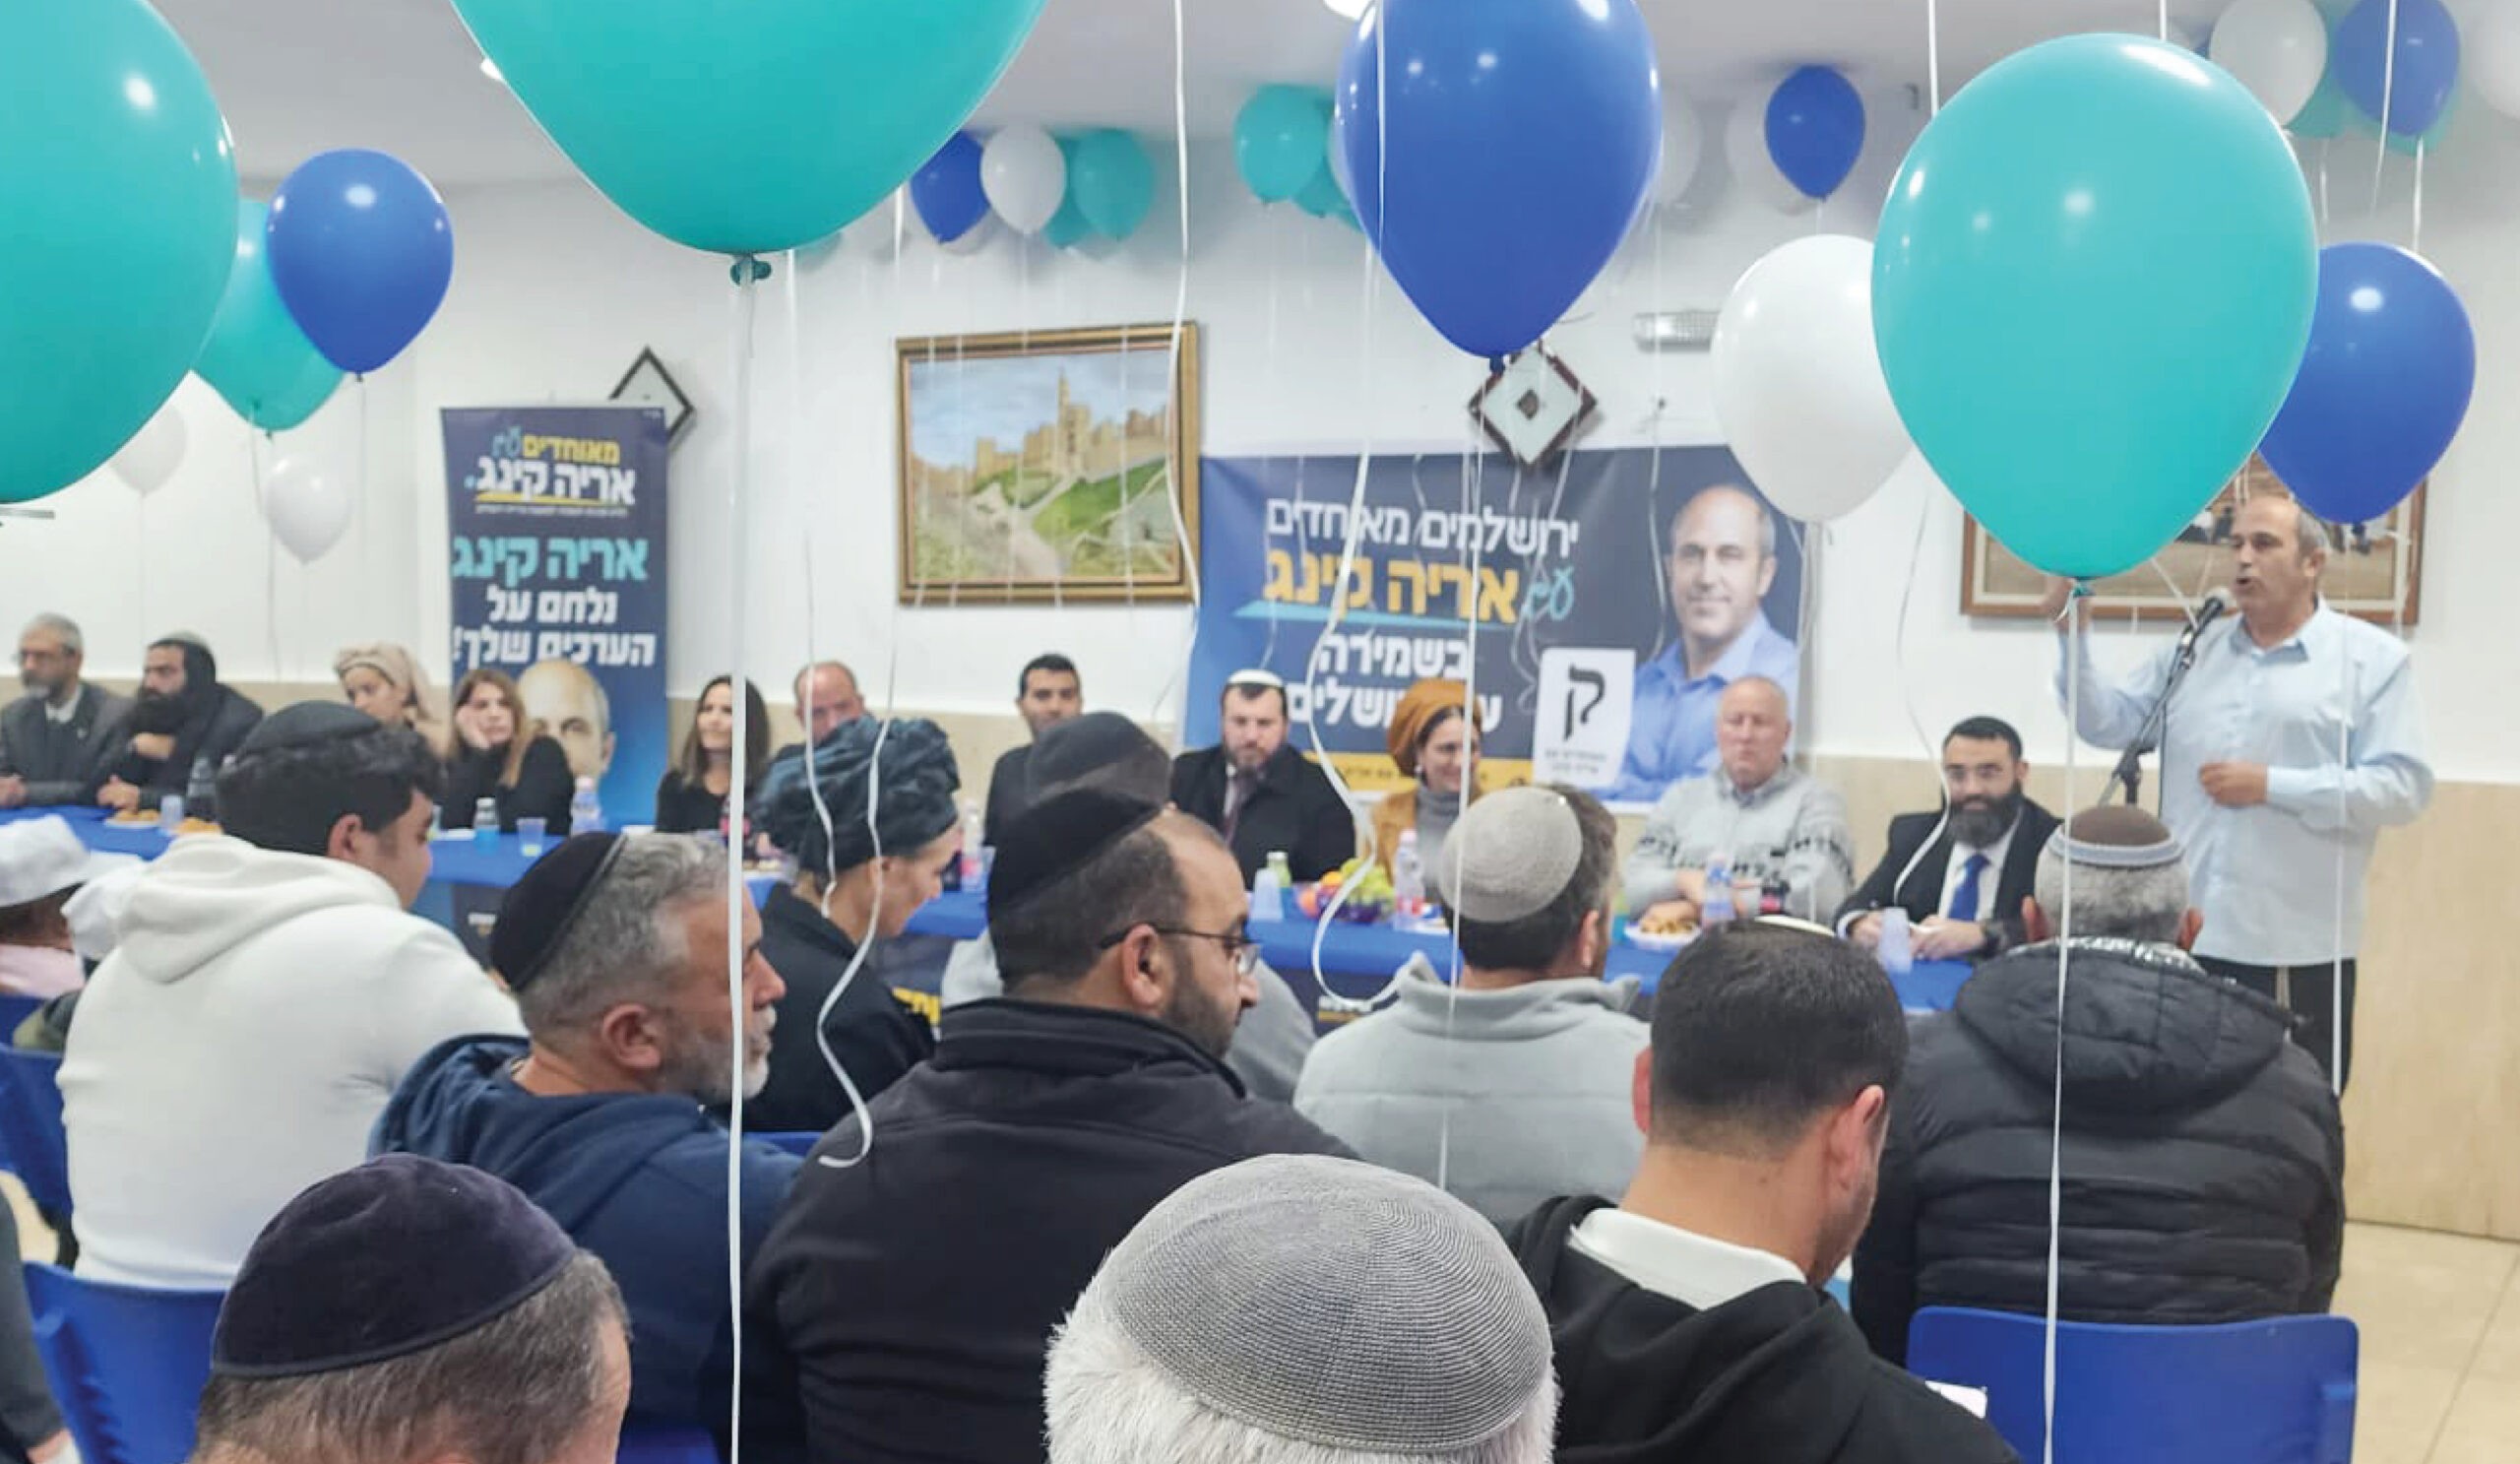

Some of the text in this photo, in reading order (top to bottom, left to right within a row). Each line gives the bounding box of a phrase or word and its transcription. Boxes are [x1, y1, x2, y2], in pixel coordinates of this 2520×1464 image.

[553, 463, 636, 505] אריה
[1267, 497, 1580, 558] ירושלמים מאחדים
[451, 536, 649, 588] אריה קינג
[486, 583, 618, 624] נלחם על
[1387, 558, 1520, 624] אריה
[452, 623, 657, 669] הערכים שלך!
[1317, 633, 1471, 679] בשמירה
[1563, 663, 1605, 742] ק
